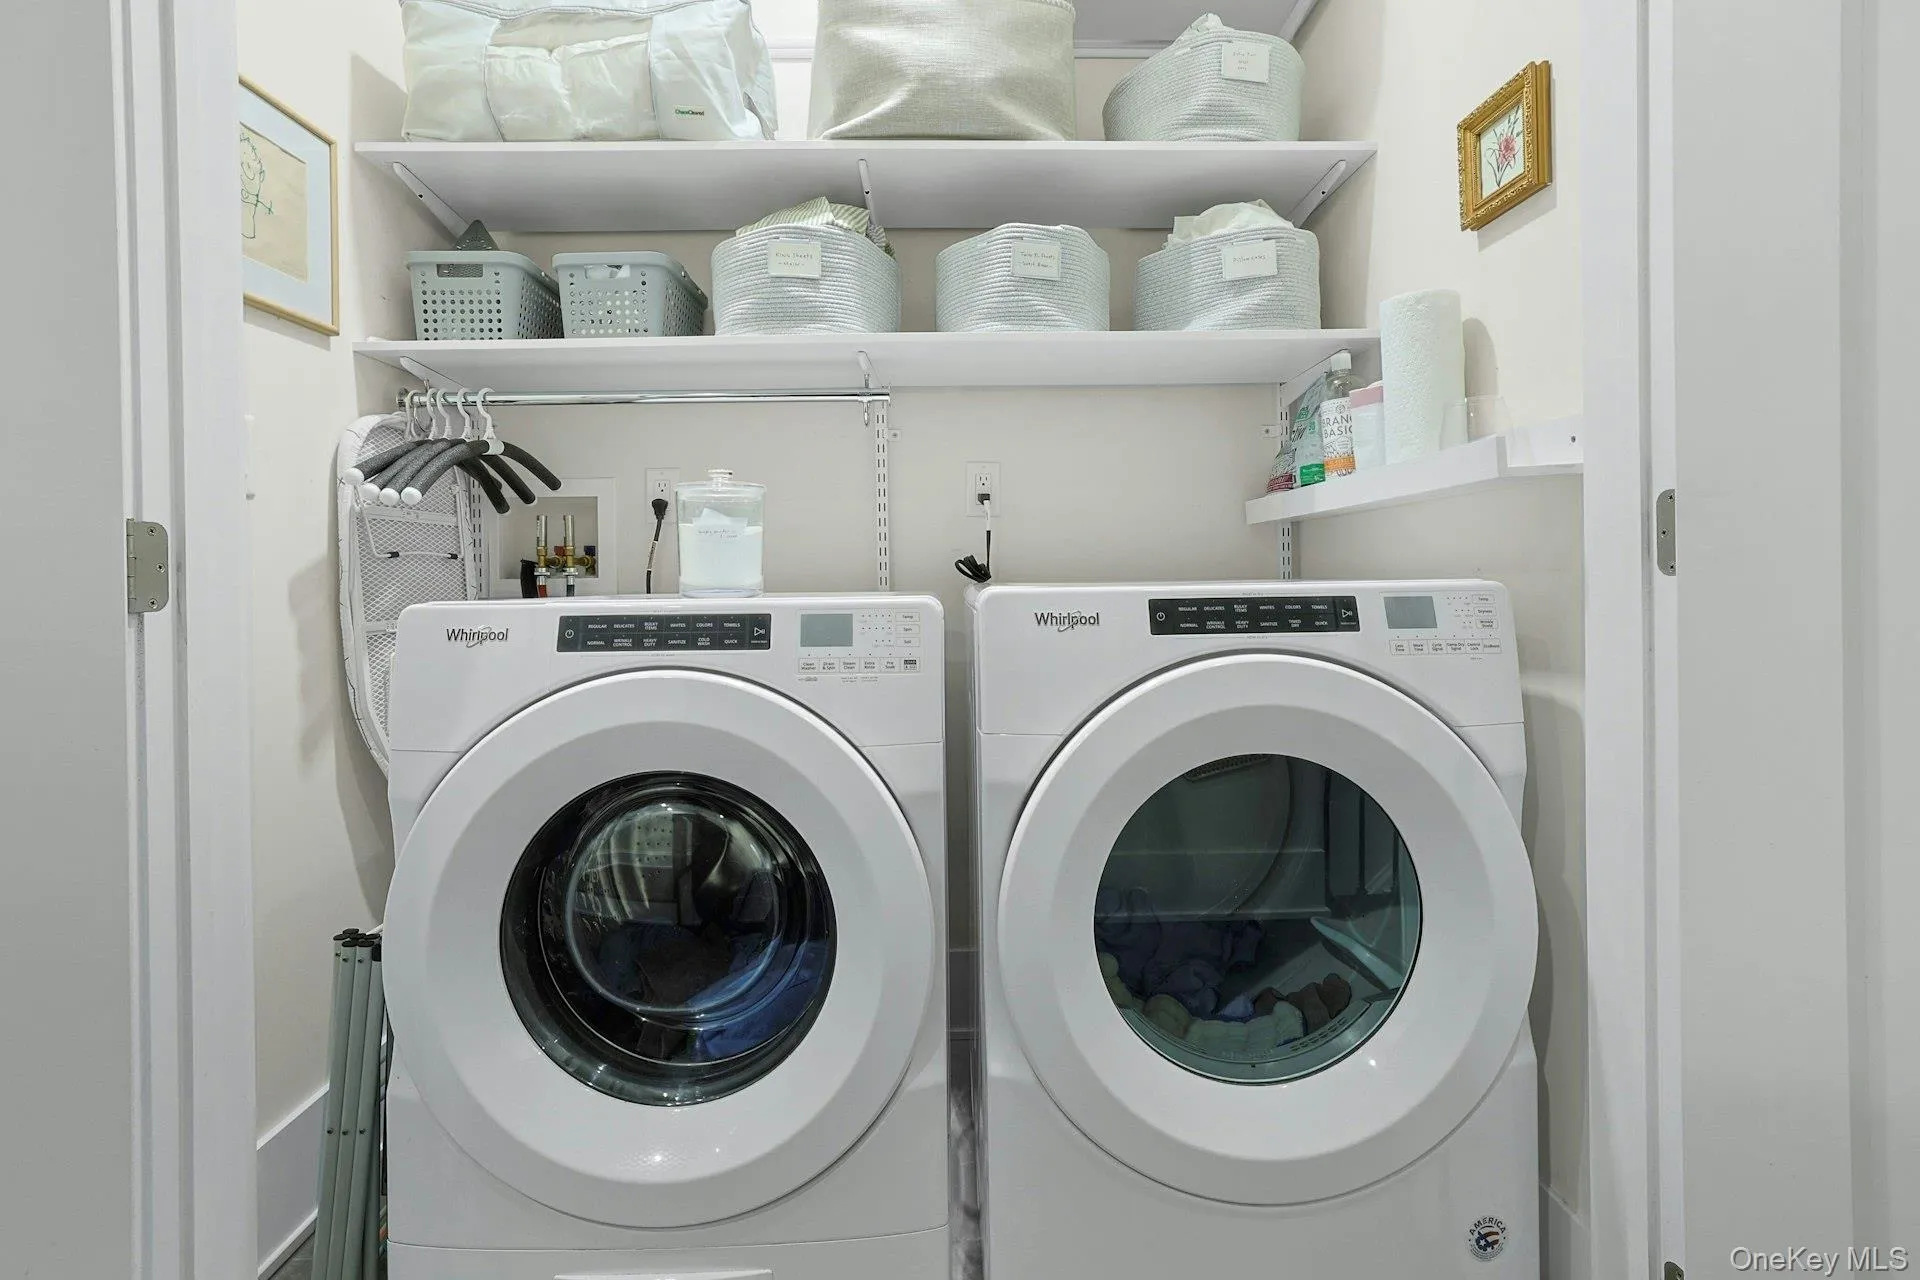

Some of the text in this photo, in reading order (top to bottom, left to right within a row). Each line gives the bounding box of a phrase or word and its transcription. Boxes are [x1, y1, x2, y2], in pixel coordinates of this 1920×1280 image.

[1034, 611, 1100, 630] Whirlpool
[446, 627, 509, 645] Whirlpool
[1469, 1217, 1506, 1236] AMERICA
